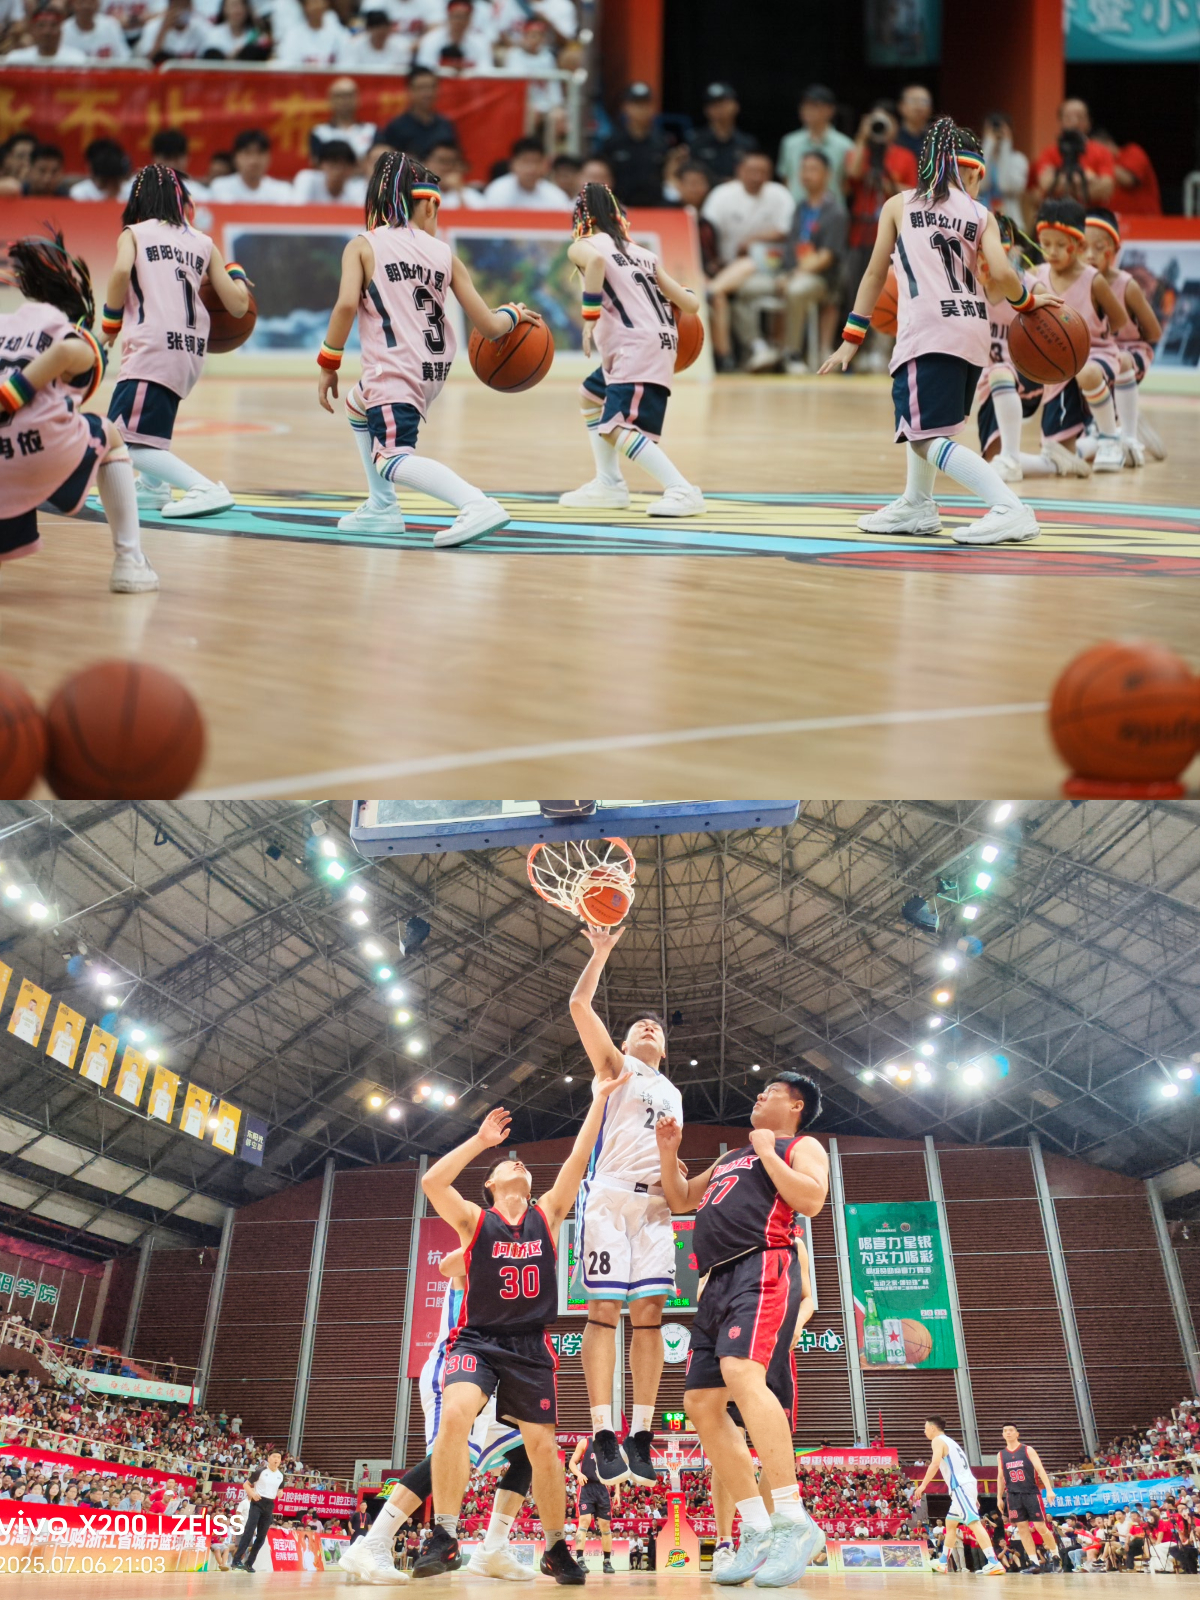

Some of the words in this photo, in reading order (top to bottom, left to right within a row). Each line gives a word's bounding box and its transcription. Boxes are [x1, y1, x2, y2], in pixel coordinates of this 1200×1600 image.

[910, 211, 978, 242] 朝阳幼儿园
[146, 245, 204, 275] 朝阳幼儿园
[930, 231, 976, 295] 11
[385, 261, 445, 292] 朝阳幼儿园
[175, 267, 196, 329] 1
[413, 286, 445, 354] 3
[492, 1239, 542, 1259] 柯桥区
[860, 1250, 934, 1264] 为实力喝彩
[588, 1251, 611, 1275] 28
[499, 1265, 540, 1299] 30
[797, 1329, 843, 1353] 中心
[446, 1354, 477, 1375] 30
[670, 1420, 680, 1429] 19
[1009, 1469, 1025, 1482] 98
